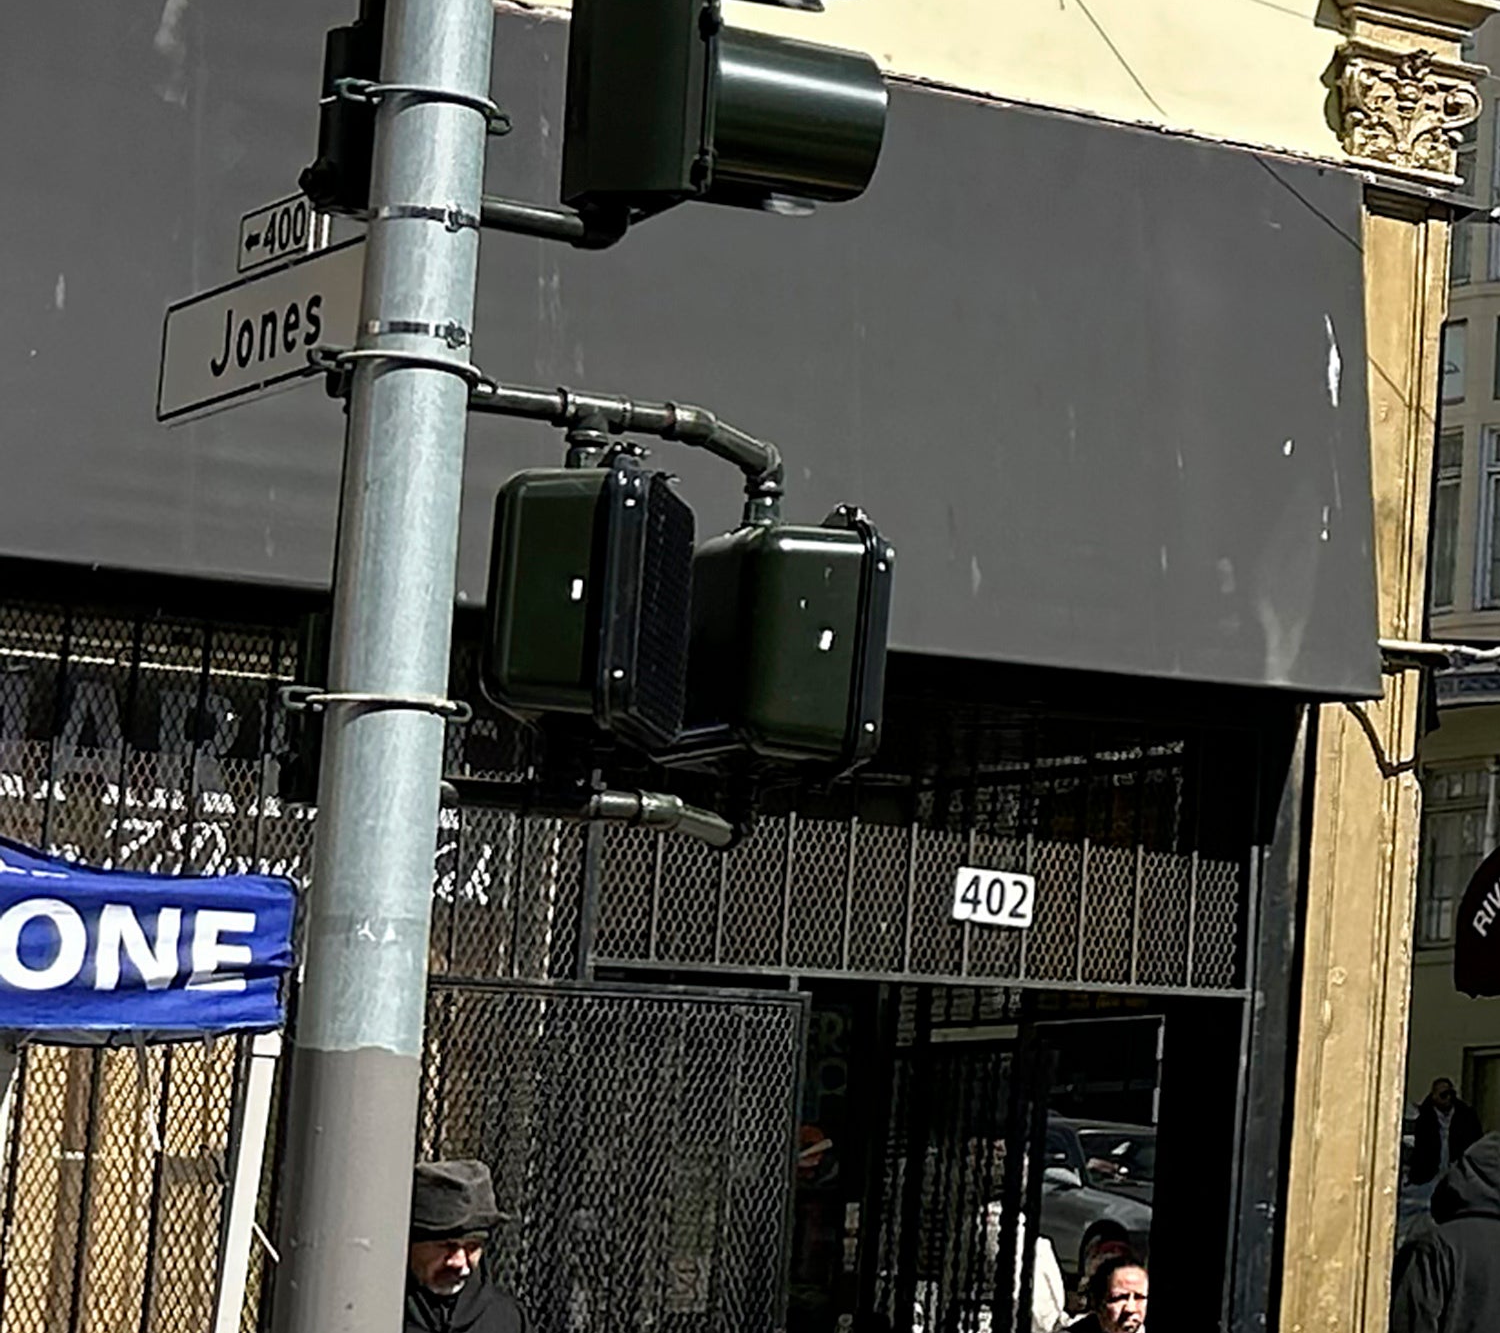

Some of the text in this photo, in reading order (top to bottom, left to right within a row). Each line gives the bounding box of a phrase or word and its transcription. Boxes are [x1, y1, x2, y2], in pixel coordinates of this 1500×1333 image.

[262, 201, 307, 254] 400
[211, 294, 323, 376] Jones
[960, 874, 1030, 919] 402
